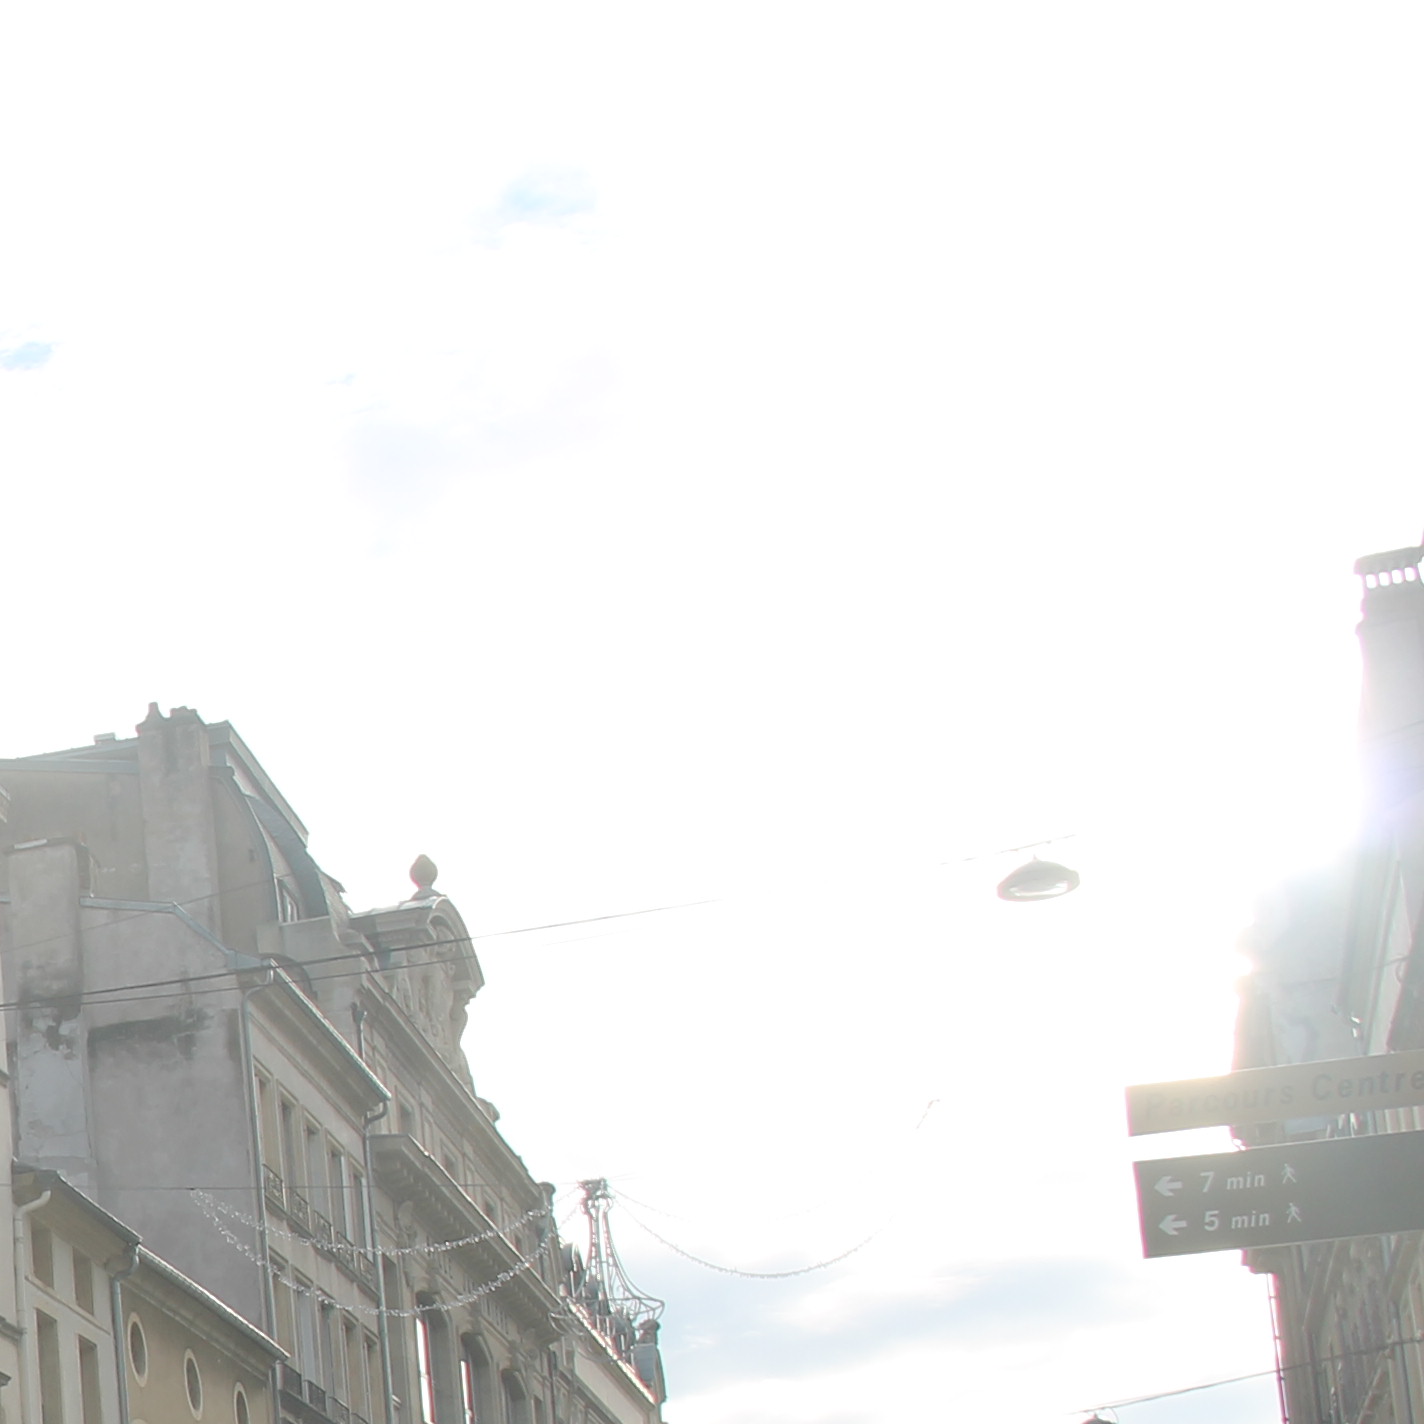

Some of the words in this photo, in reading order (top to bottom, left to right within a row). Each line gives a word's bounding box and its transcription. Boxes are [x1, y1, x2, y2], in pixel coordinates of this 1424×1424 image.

[1145, 1083, 1294, 1119] Parcours
[1311, 1068, 1424, 1102] Centre
[1199, 1170, 1216, 1193] 7
[1225, 1171, 1266, 1191] min
[1203, 1209, 1220, 1232] 5
[1230, 1210, 1271, 1230] min
